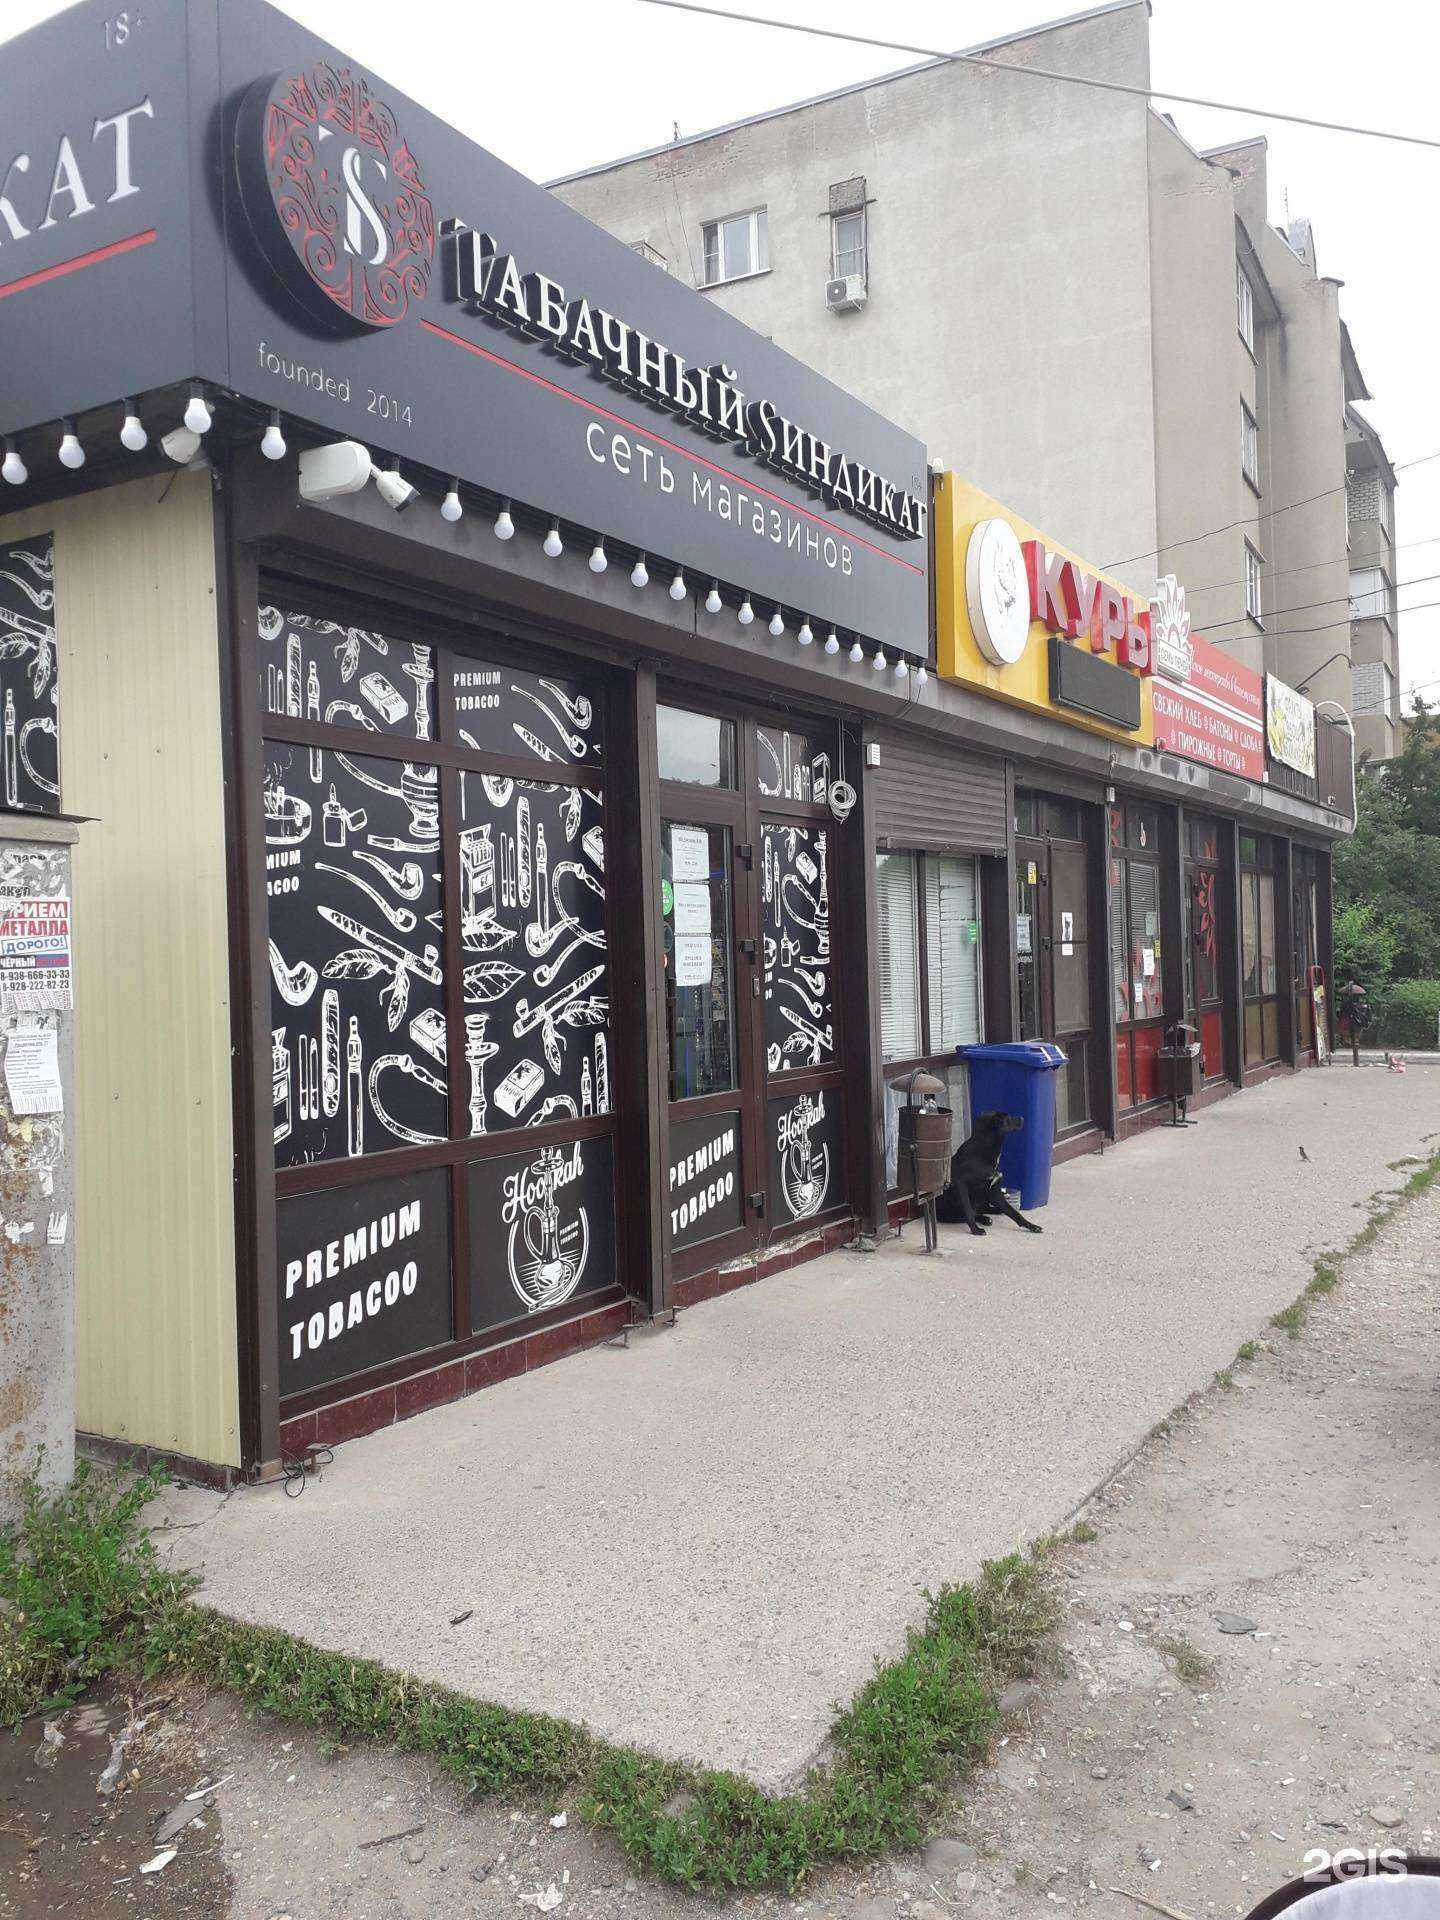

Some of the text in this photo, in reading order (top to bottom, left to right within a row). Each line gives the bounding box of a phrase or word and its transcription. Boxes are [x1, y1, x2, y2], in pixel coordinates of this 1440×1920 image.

[446, 217, 748, 440] ТАБАЧНЫЙ
[258, 342, 412, 428] founded 2014
[692, 471, 852, 576] магазинов
[1026, 540, 1158, 677] КУРЫ
[453, 671, 501, 687] PREMIUM
[1152, 691, 1184, 722] СВЕЖИЙ
[1184, 701, 1202, 729] ХЛЕБ
[1208, 719, 1233, 743] БАТОНЫ
[1177, 731, 1217, 763] ПИРОЖНЫЕ
[0, 969, 70, 982] 8-938-666-33-33
[6, 938, 65, 954] ДОРОГО!
[668, 1128, 735, 1193] PREMIUM
[670, 1171, 735, 1236] TOBACOO
[285, 1199, 422, 1301] PREMIUM
[289, 1260, 419, 1361] TOBACOO
